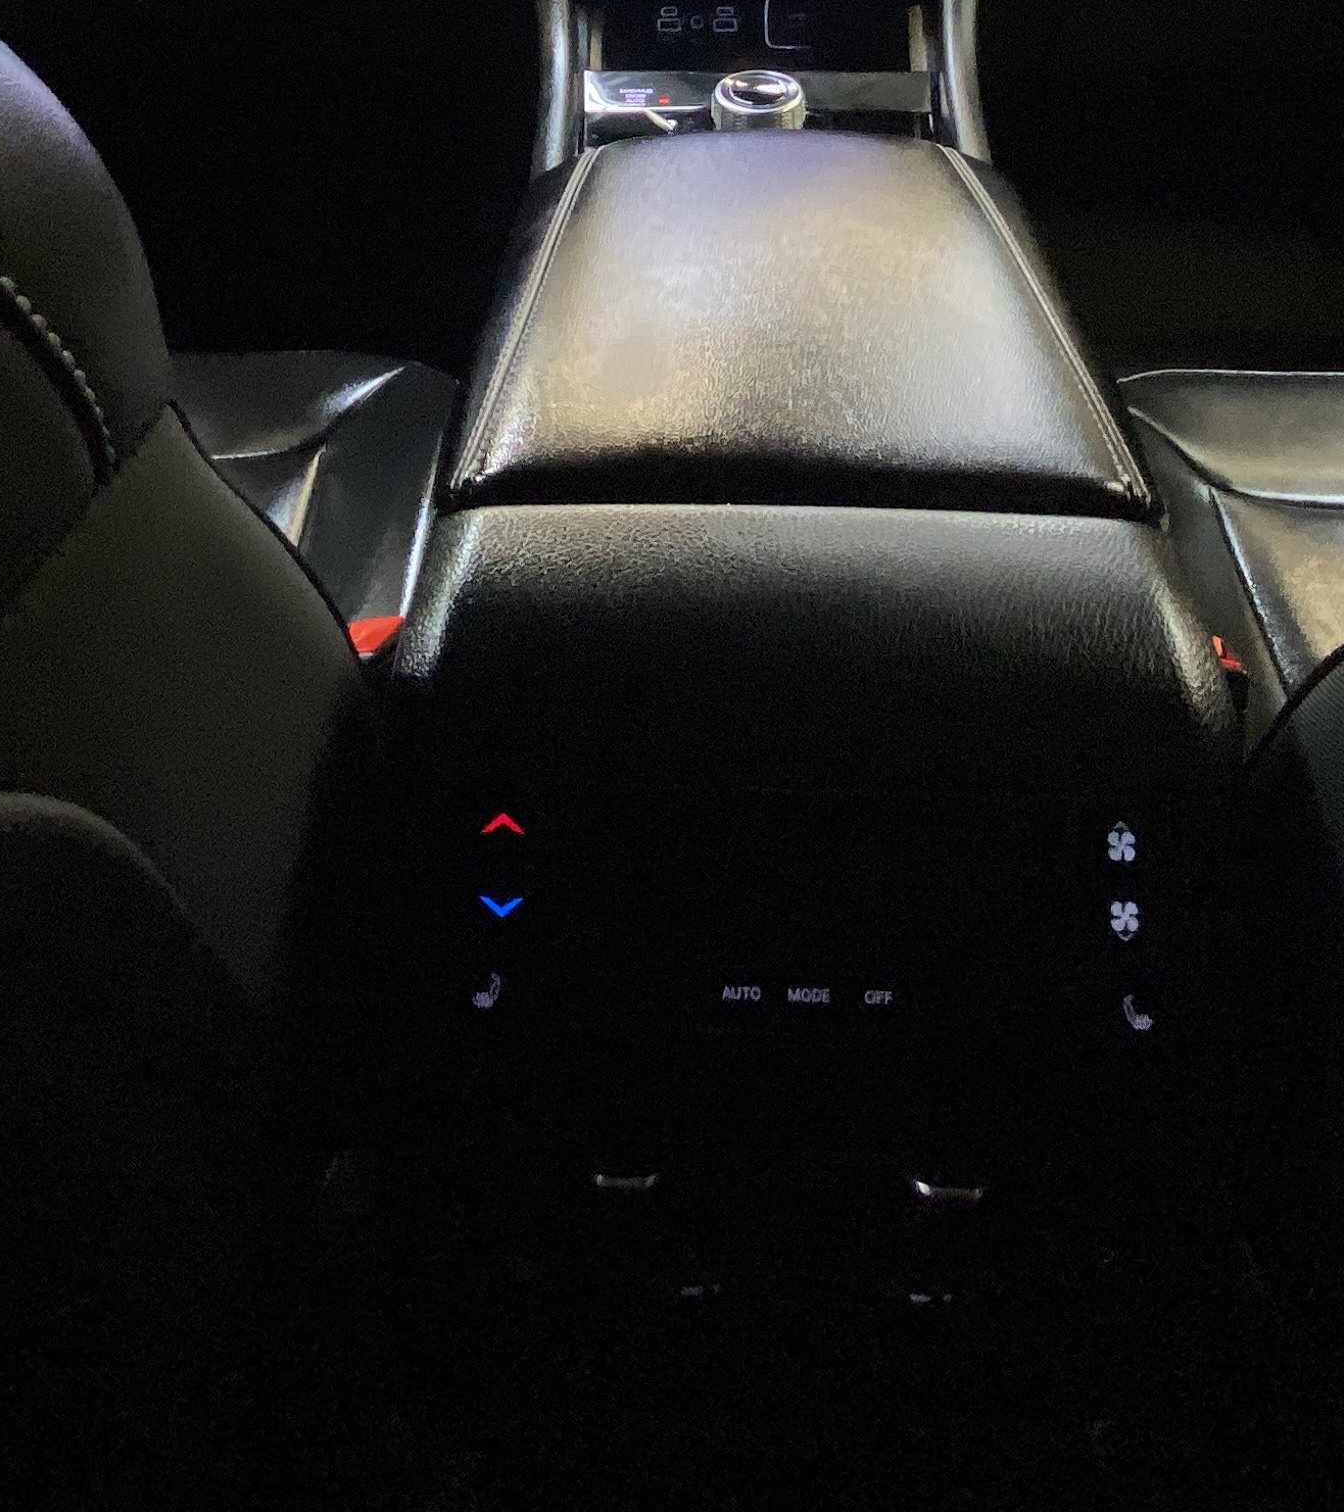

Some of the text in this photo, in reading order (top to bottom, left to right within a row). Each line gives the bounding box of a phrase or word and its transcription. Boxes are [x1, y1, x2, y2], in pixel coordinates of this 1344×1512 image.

[721, 985, 762, 1002] AUTO
[787, 987, 832, 1004] MODE
[863, 989, 894, 1005] OFF
